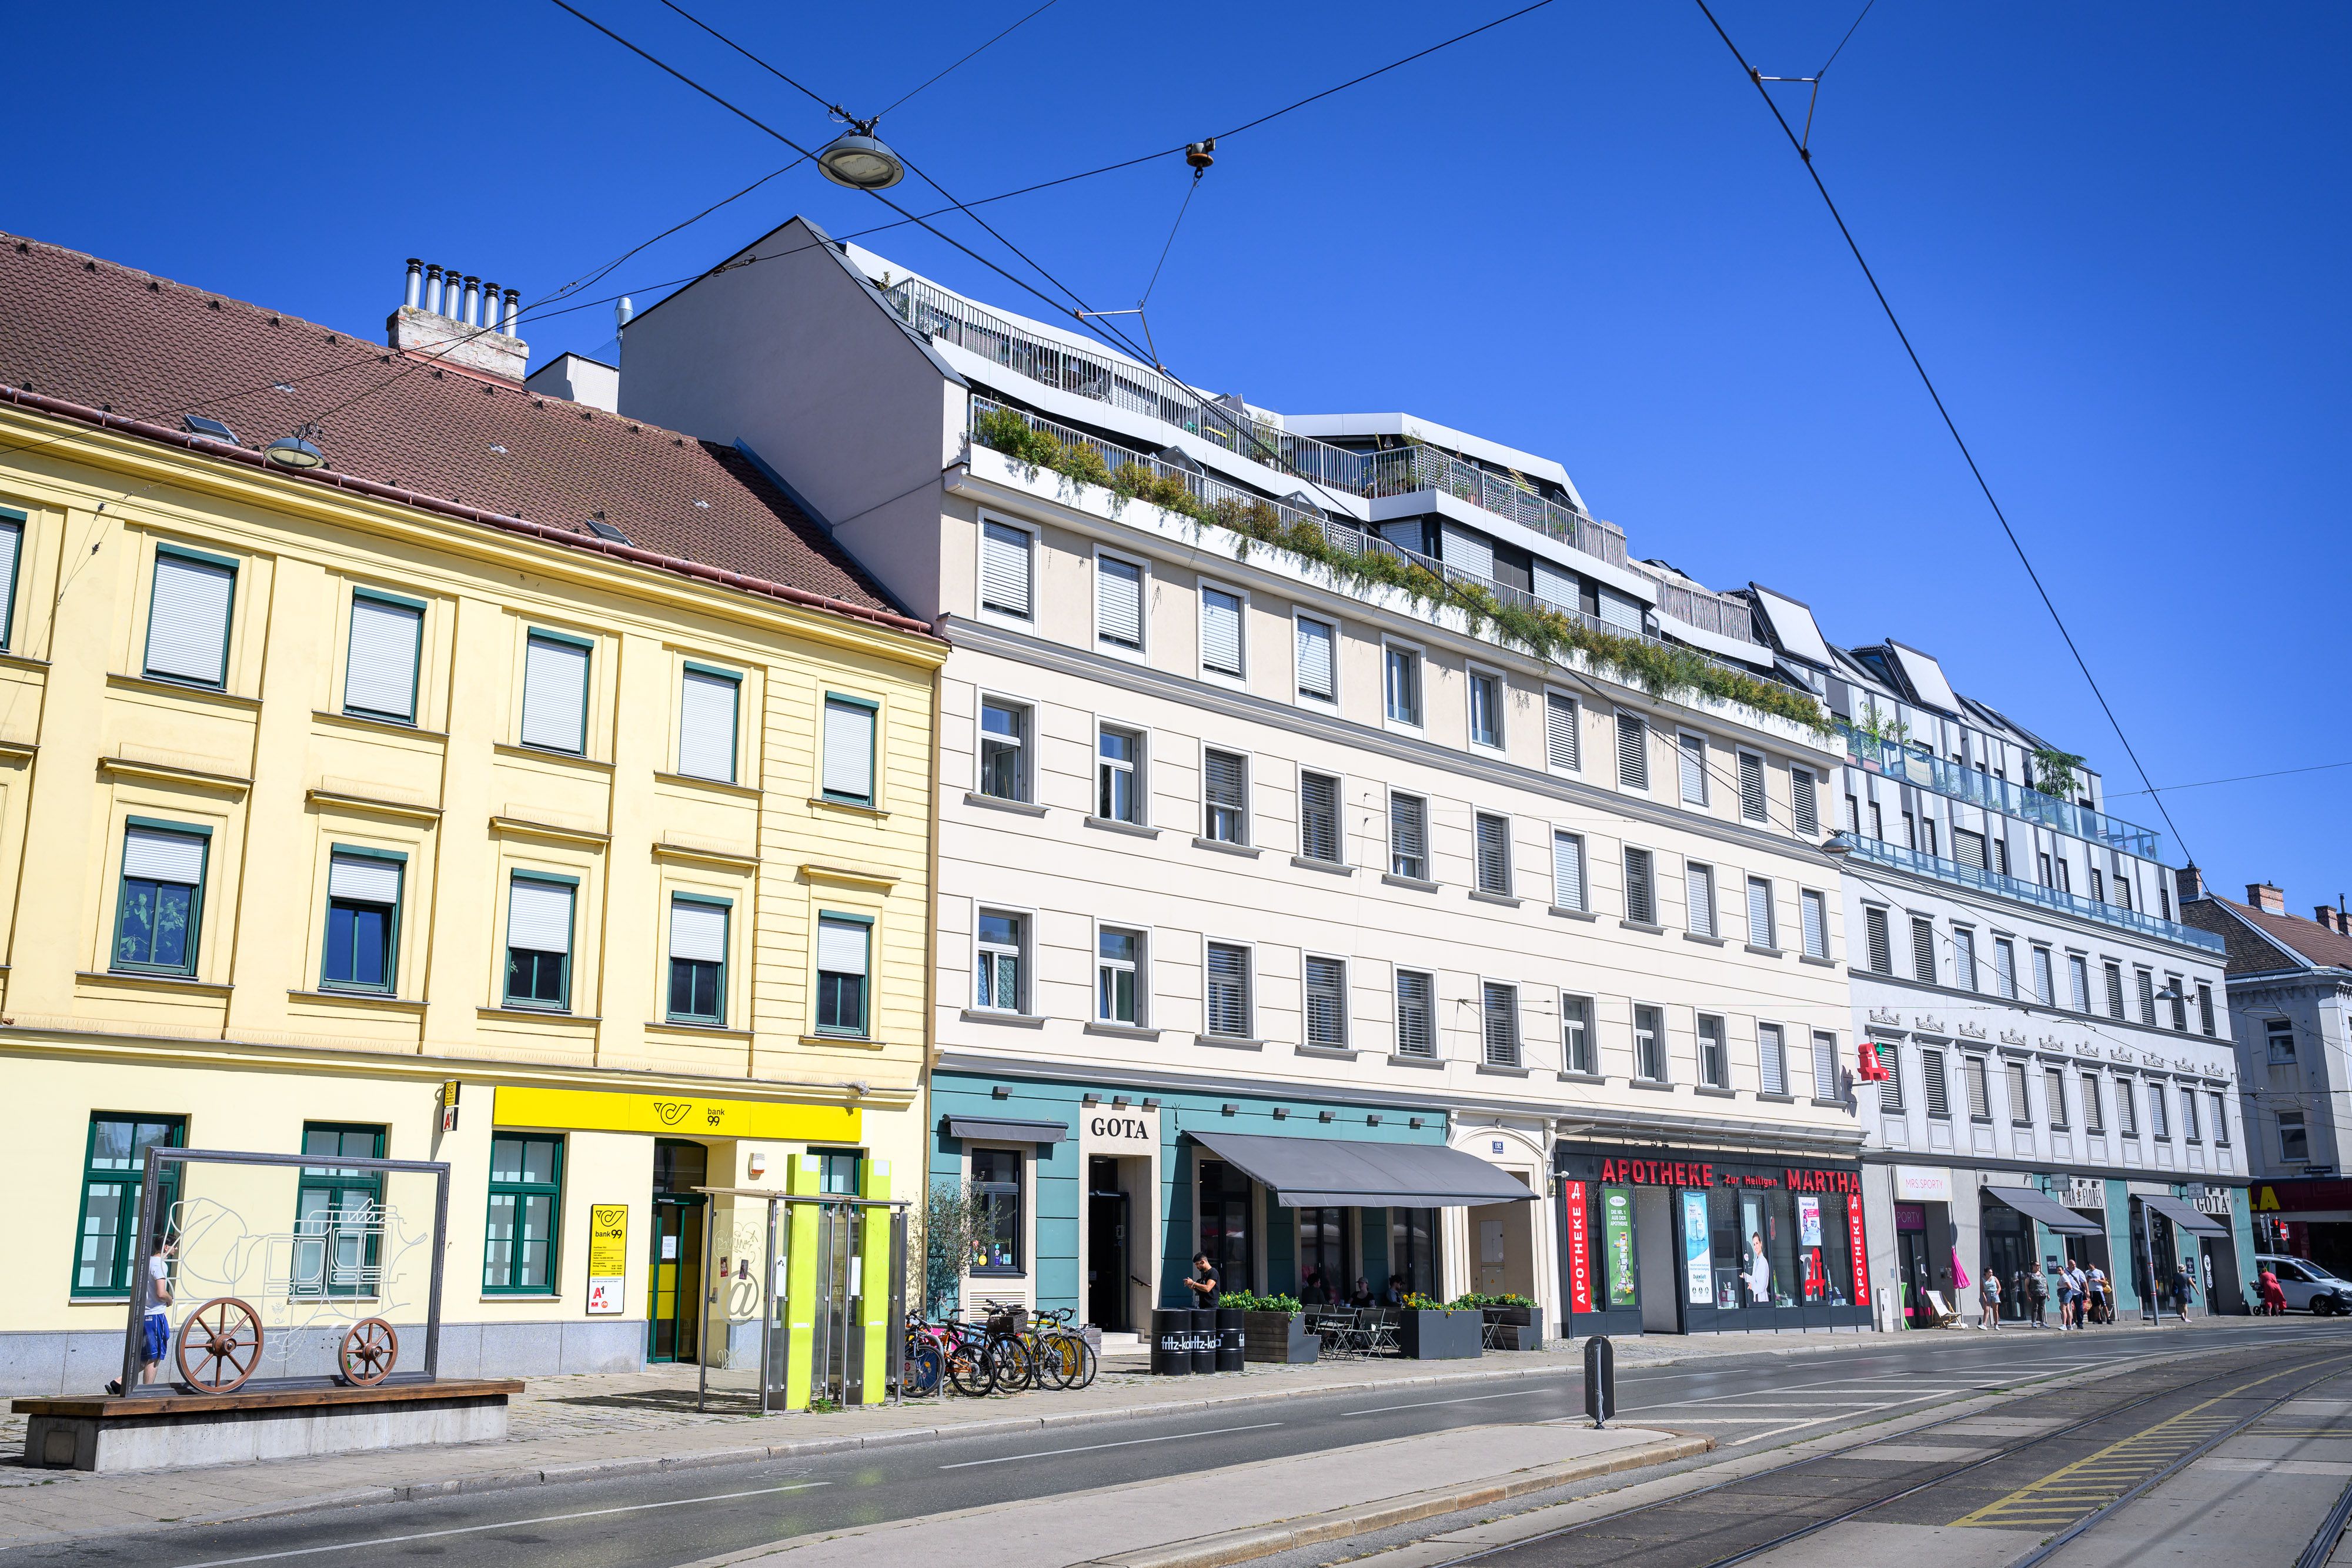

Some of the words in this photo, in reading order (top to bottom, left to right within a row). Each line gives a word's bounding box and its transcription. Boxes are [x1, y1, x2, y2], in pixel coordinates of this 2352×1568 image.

[447, 1084, 454, 1094] SB
[707, 1107, 725, 1115] bank
[444, 1111, 453, 1130] A1
[707, 1115, 720, 1126] 99
[1091, 1117, 1149, 1139] GOTA
[1602, 1158, 1713, 1186] APOTHEKE
[1725, 1174, 1739, 1184] Zur
[1745, 1175, 1778, 1187] Heiligen
[1786, 1169, 1861, 1193] MARTHA
[1906, 1179, 1943, 1189] MRS.SPORTY
[2062, 1188, 2076, 1207] MIRA
[2082, 1188, 2103, 1208] FLORES
[611, 1229, 623, 1239] 99
[1573, 1207, 1586, 1304] APOTHEKE
[1853, 1216, 1865, 1298] APOTHEKE
[593, 1286, 604, 1299] A1
